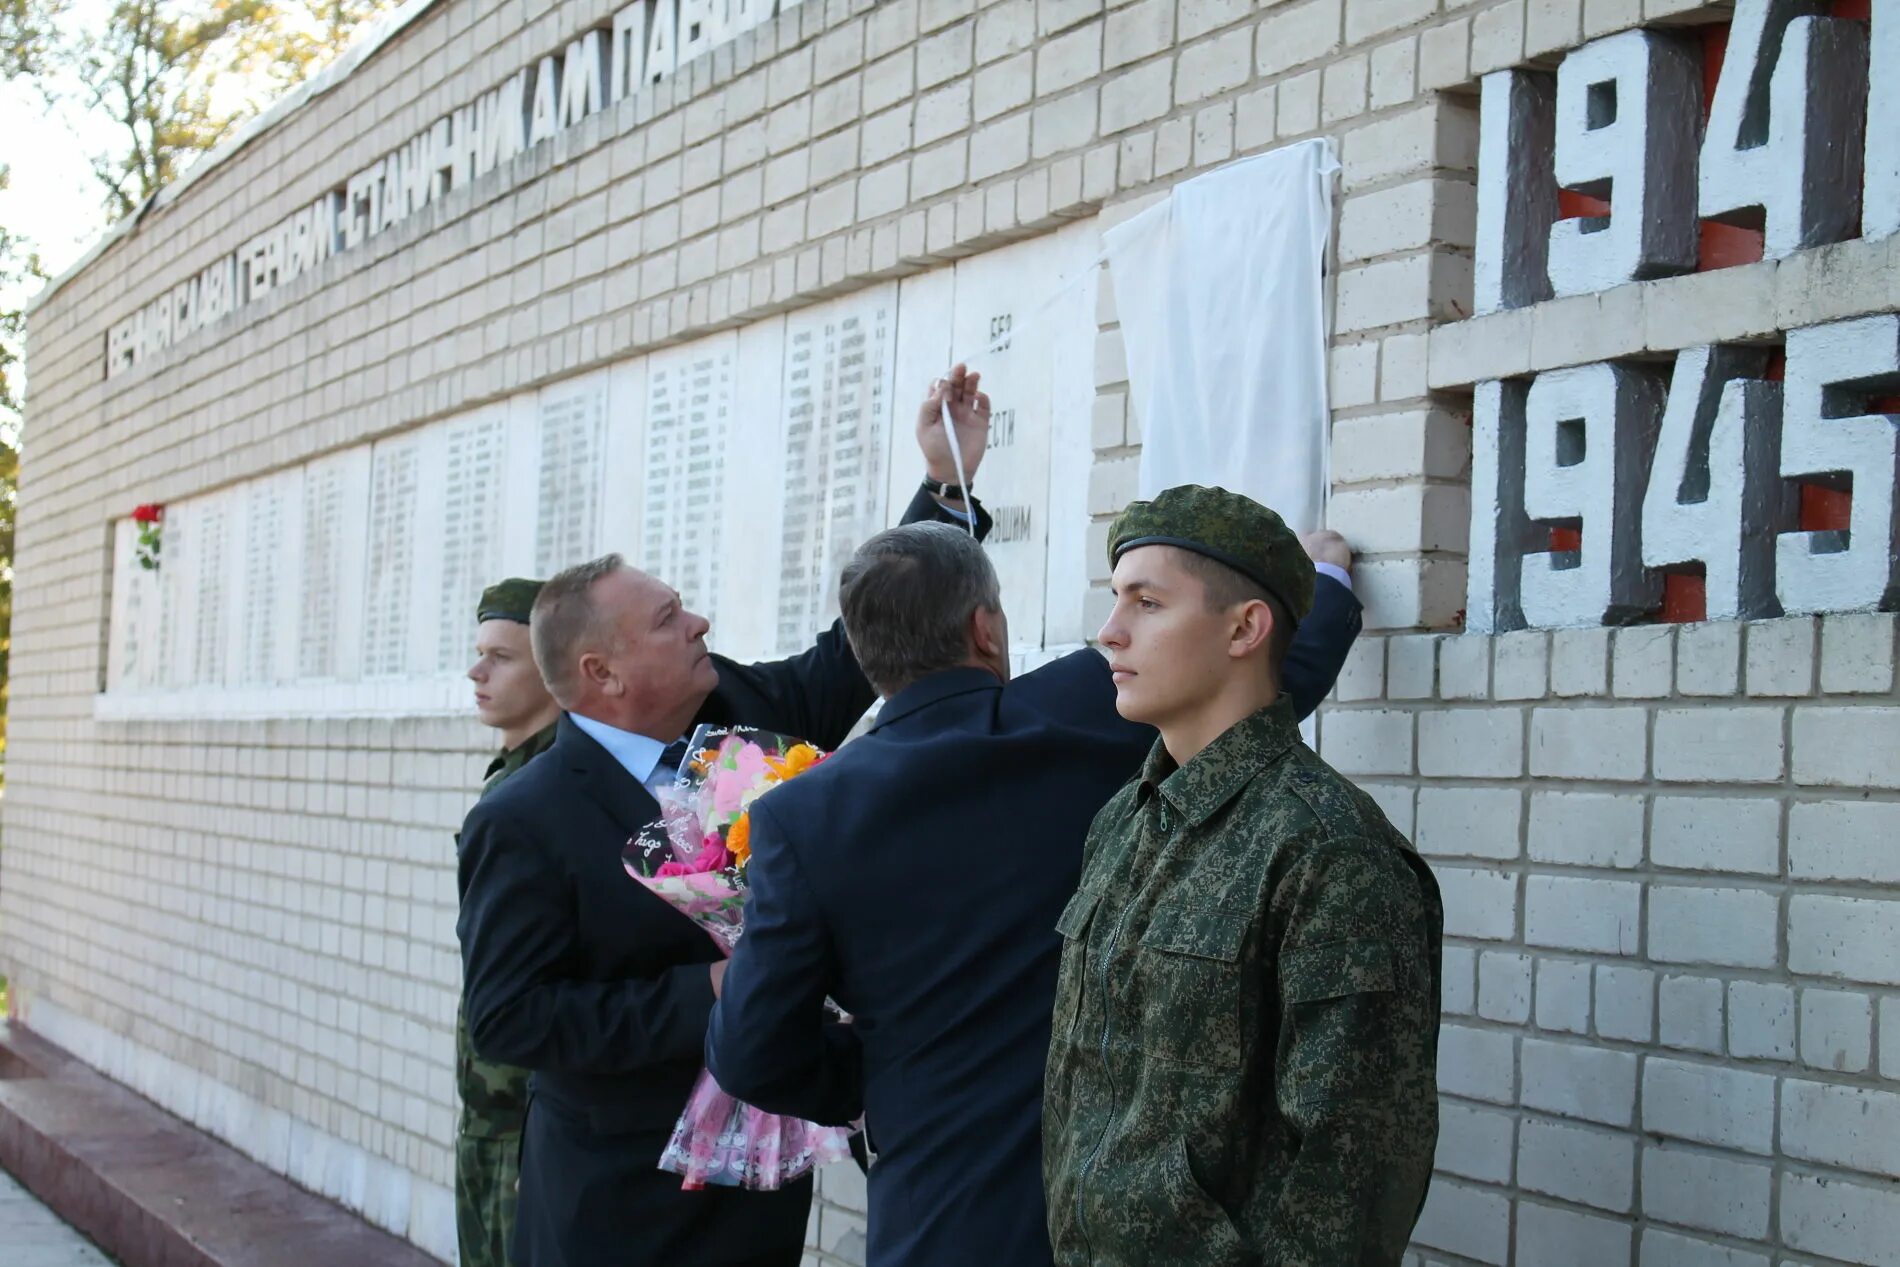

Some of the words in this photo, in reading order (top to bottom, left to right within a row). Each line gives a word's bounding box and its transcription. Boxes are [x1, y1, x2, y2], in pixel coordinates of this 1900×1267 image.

[1474, 0, 1900, 318] 1941
[986, 409, 1016, 450] ЕСТИ
[1466, 313, 1900, 635] 1945
